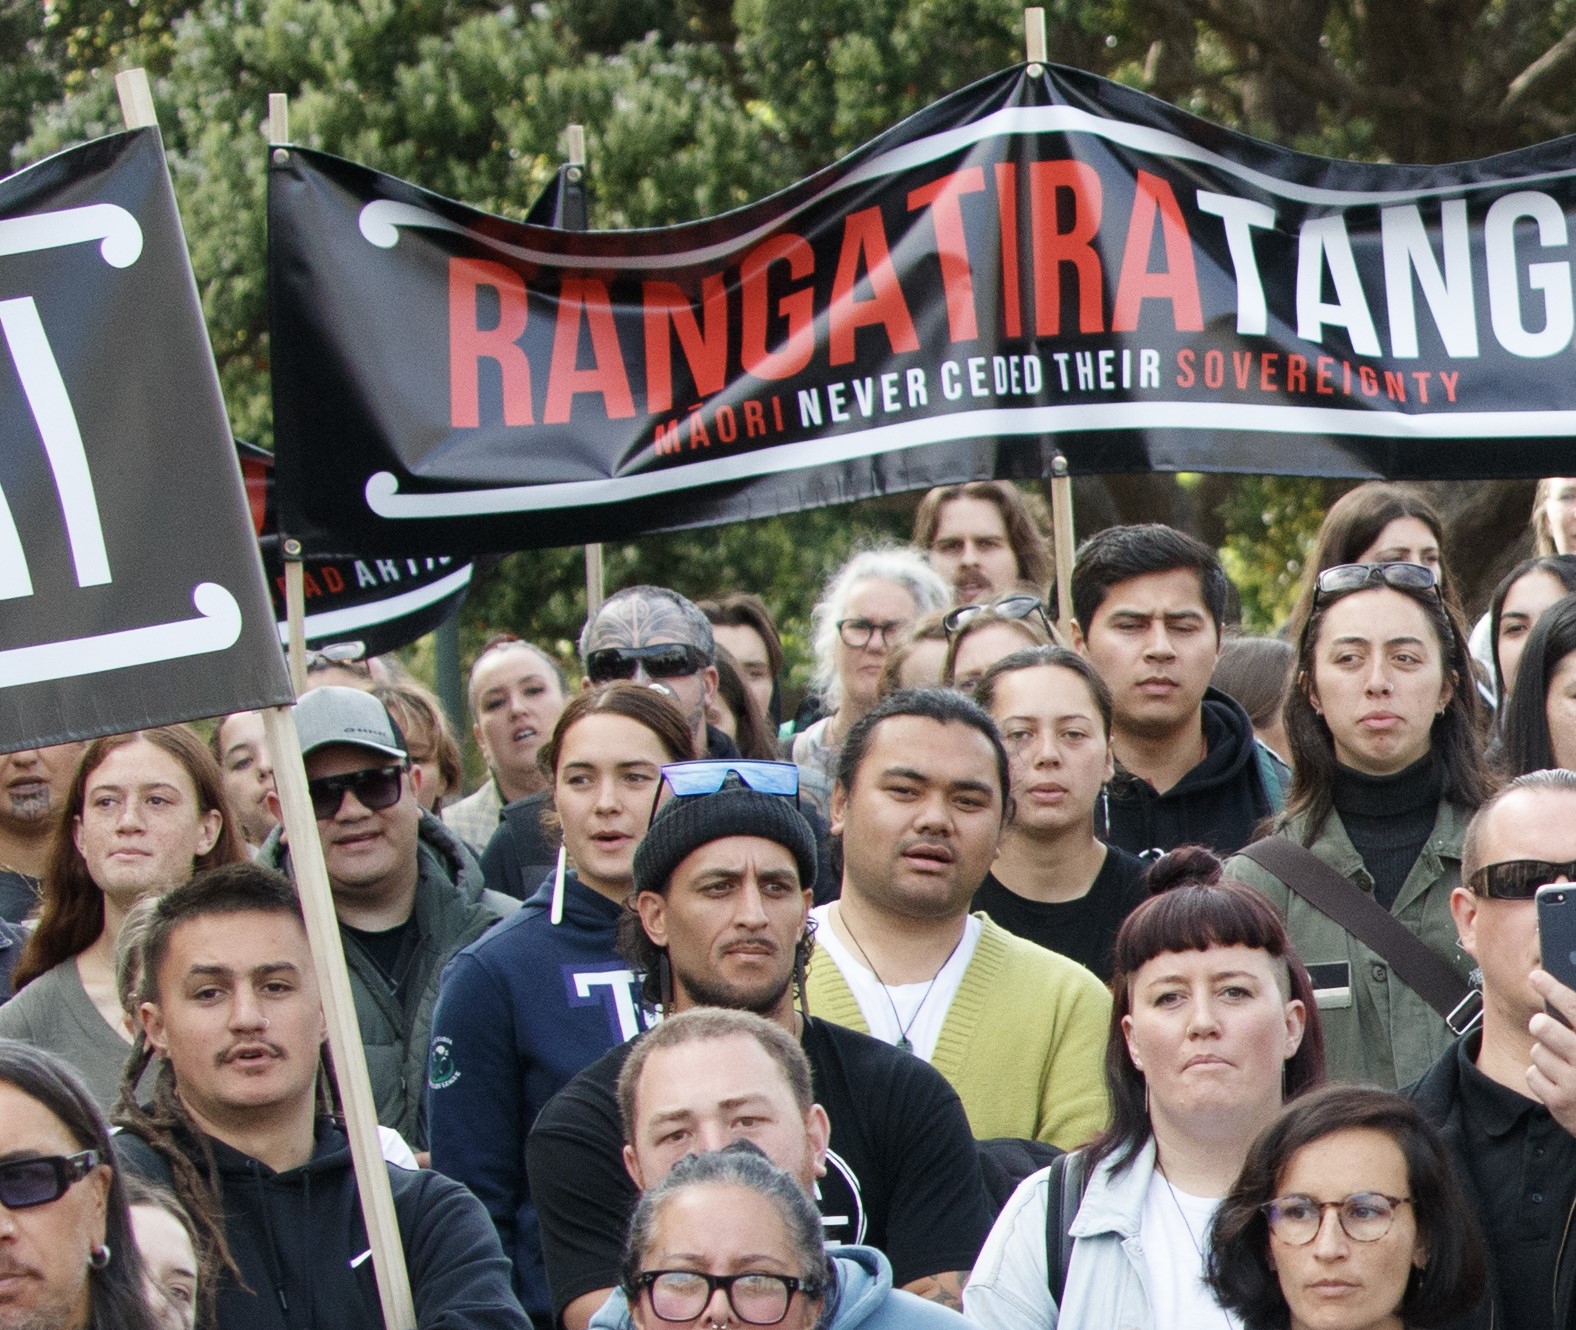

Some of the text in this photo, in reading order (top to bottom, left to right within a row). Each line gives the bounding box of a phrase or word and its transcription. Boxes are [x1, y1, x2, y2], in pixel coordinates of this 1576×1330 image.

[654, 348, 1460, 457] MĀORI NEVER CEDED THEIR SOVEREIGNTY
